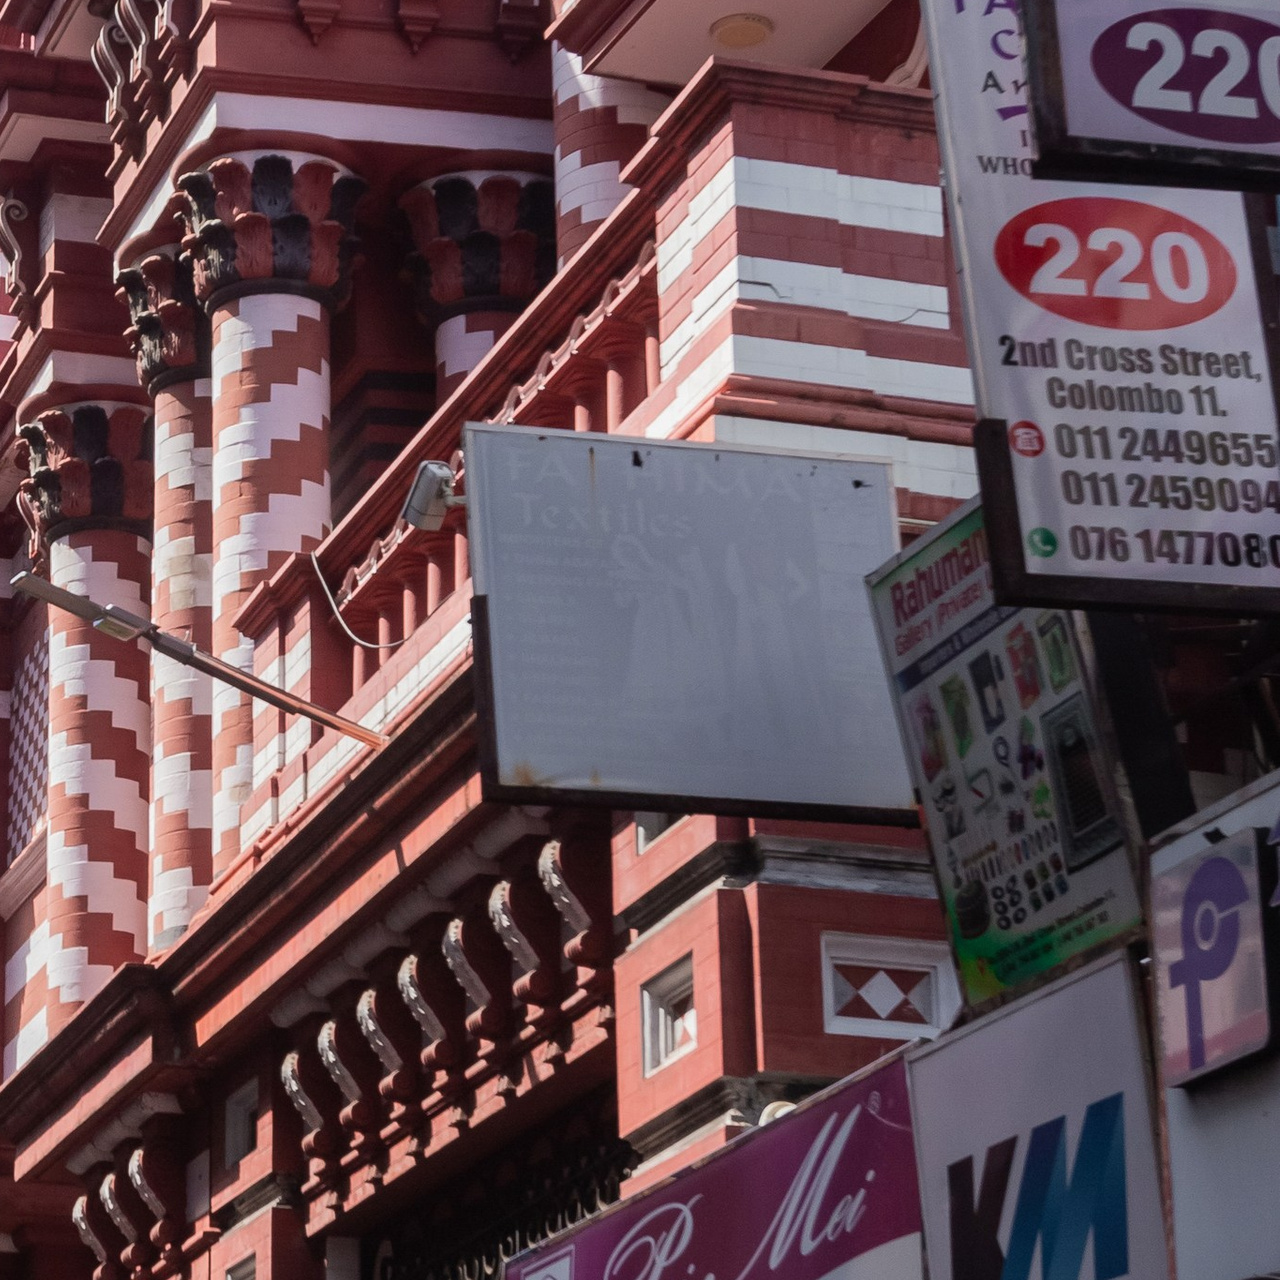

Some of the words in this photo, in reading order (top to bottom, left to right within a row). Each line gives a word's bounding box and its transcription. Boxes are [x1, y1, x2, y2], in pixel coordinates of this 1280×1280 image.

[1023, 223, 1210, 305] 220
[999, 334, 1057, 369] 2nd
[1064, 338, 1153, 376] Cross
[1159, 342, 1263, 384] Street,
[1046, 376, 1184, 417] Colombo
[1189, 385, 1228, 418] 11.
[1053, 422, 1113, 462] 011
[1120, 426, 1277, 469] 2449655
[1061, 468, 1120, 508] 011
[1068, 524, 1131, 562] 076
